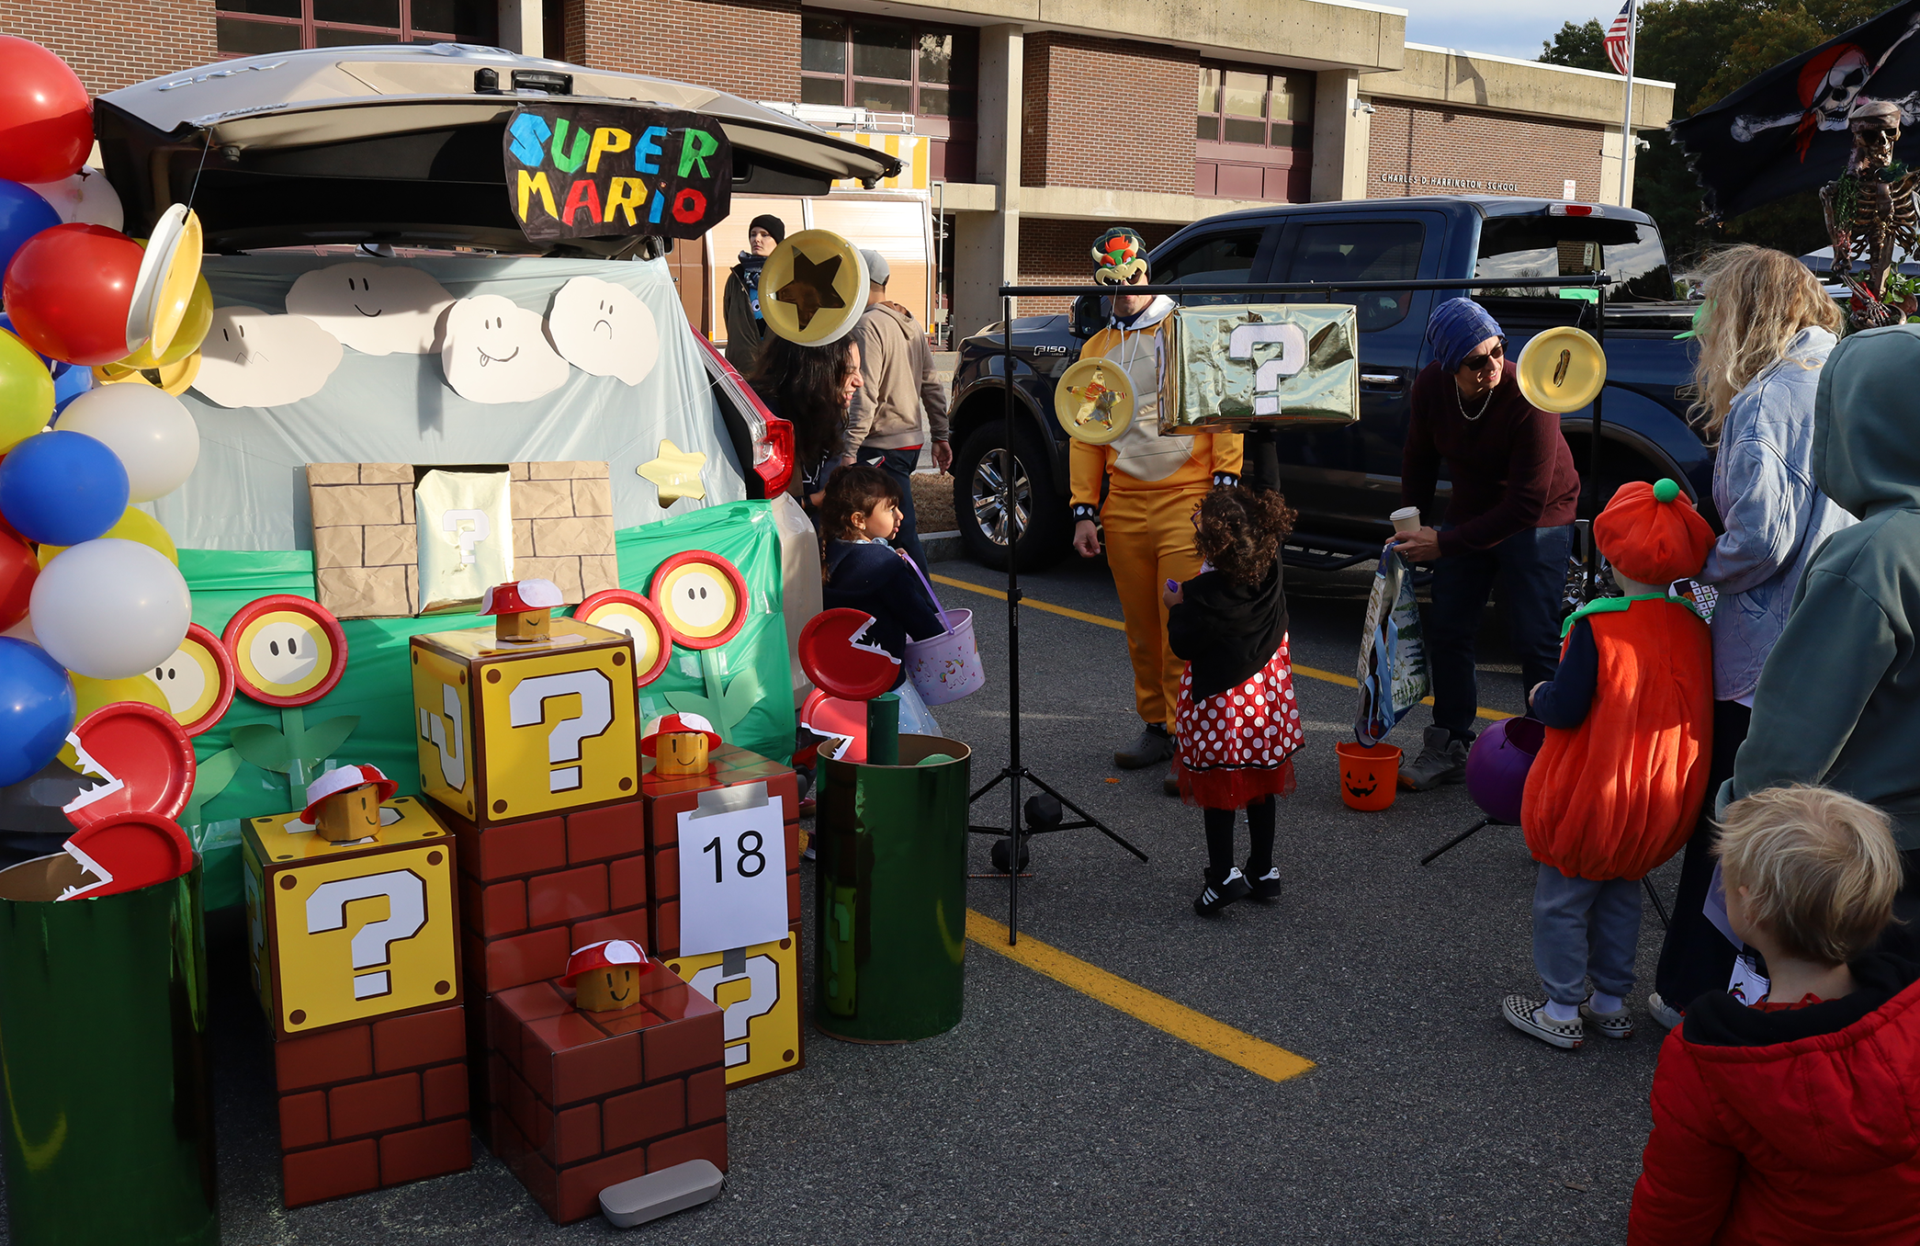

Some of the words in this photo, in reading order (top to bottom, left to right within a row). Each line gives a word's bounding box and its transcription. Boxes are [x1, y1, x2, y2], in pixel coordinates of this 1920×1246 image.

[509, 113, 719, 178] SUPER
[1380, 173, 1418, 184] CHARLES
[1421, 176, 1427, 185] D
[1430, 177, 1482, 189] HARRINGTON
[1487, 181, 1518, 192] SCHOOL
[703, 830, 766, 883] 18
